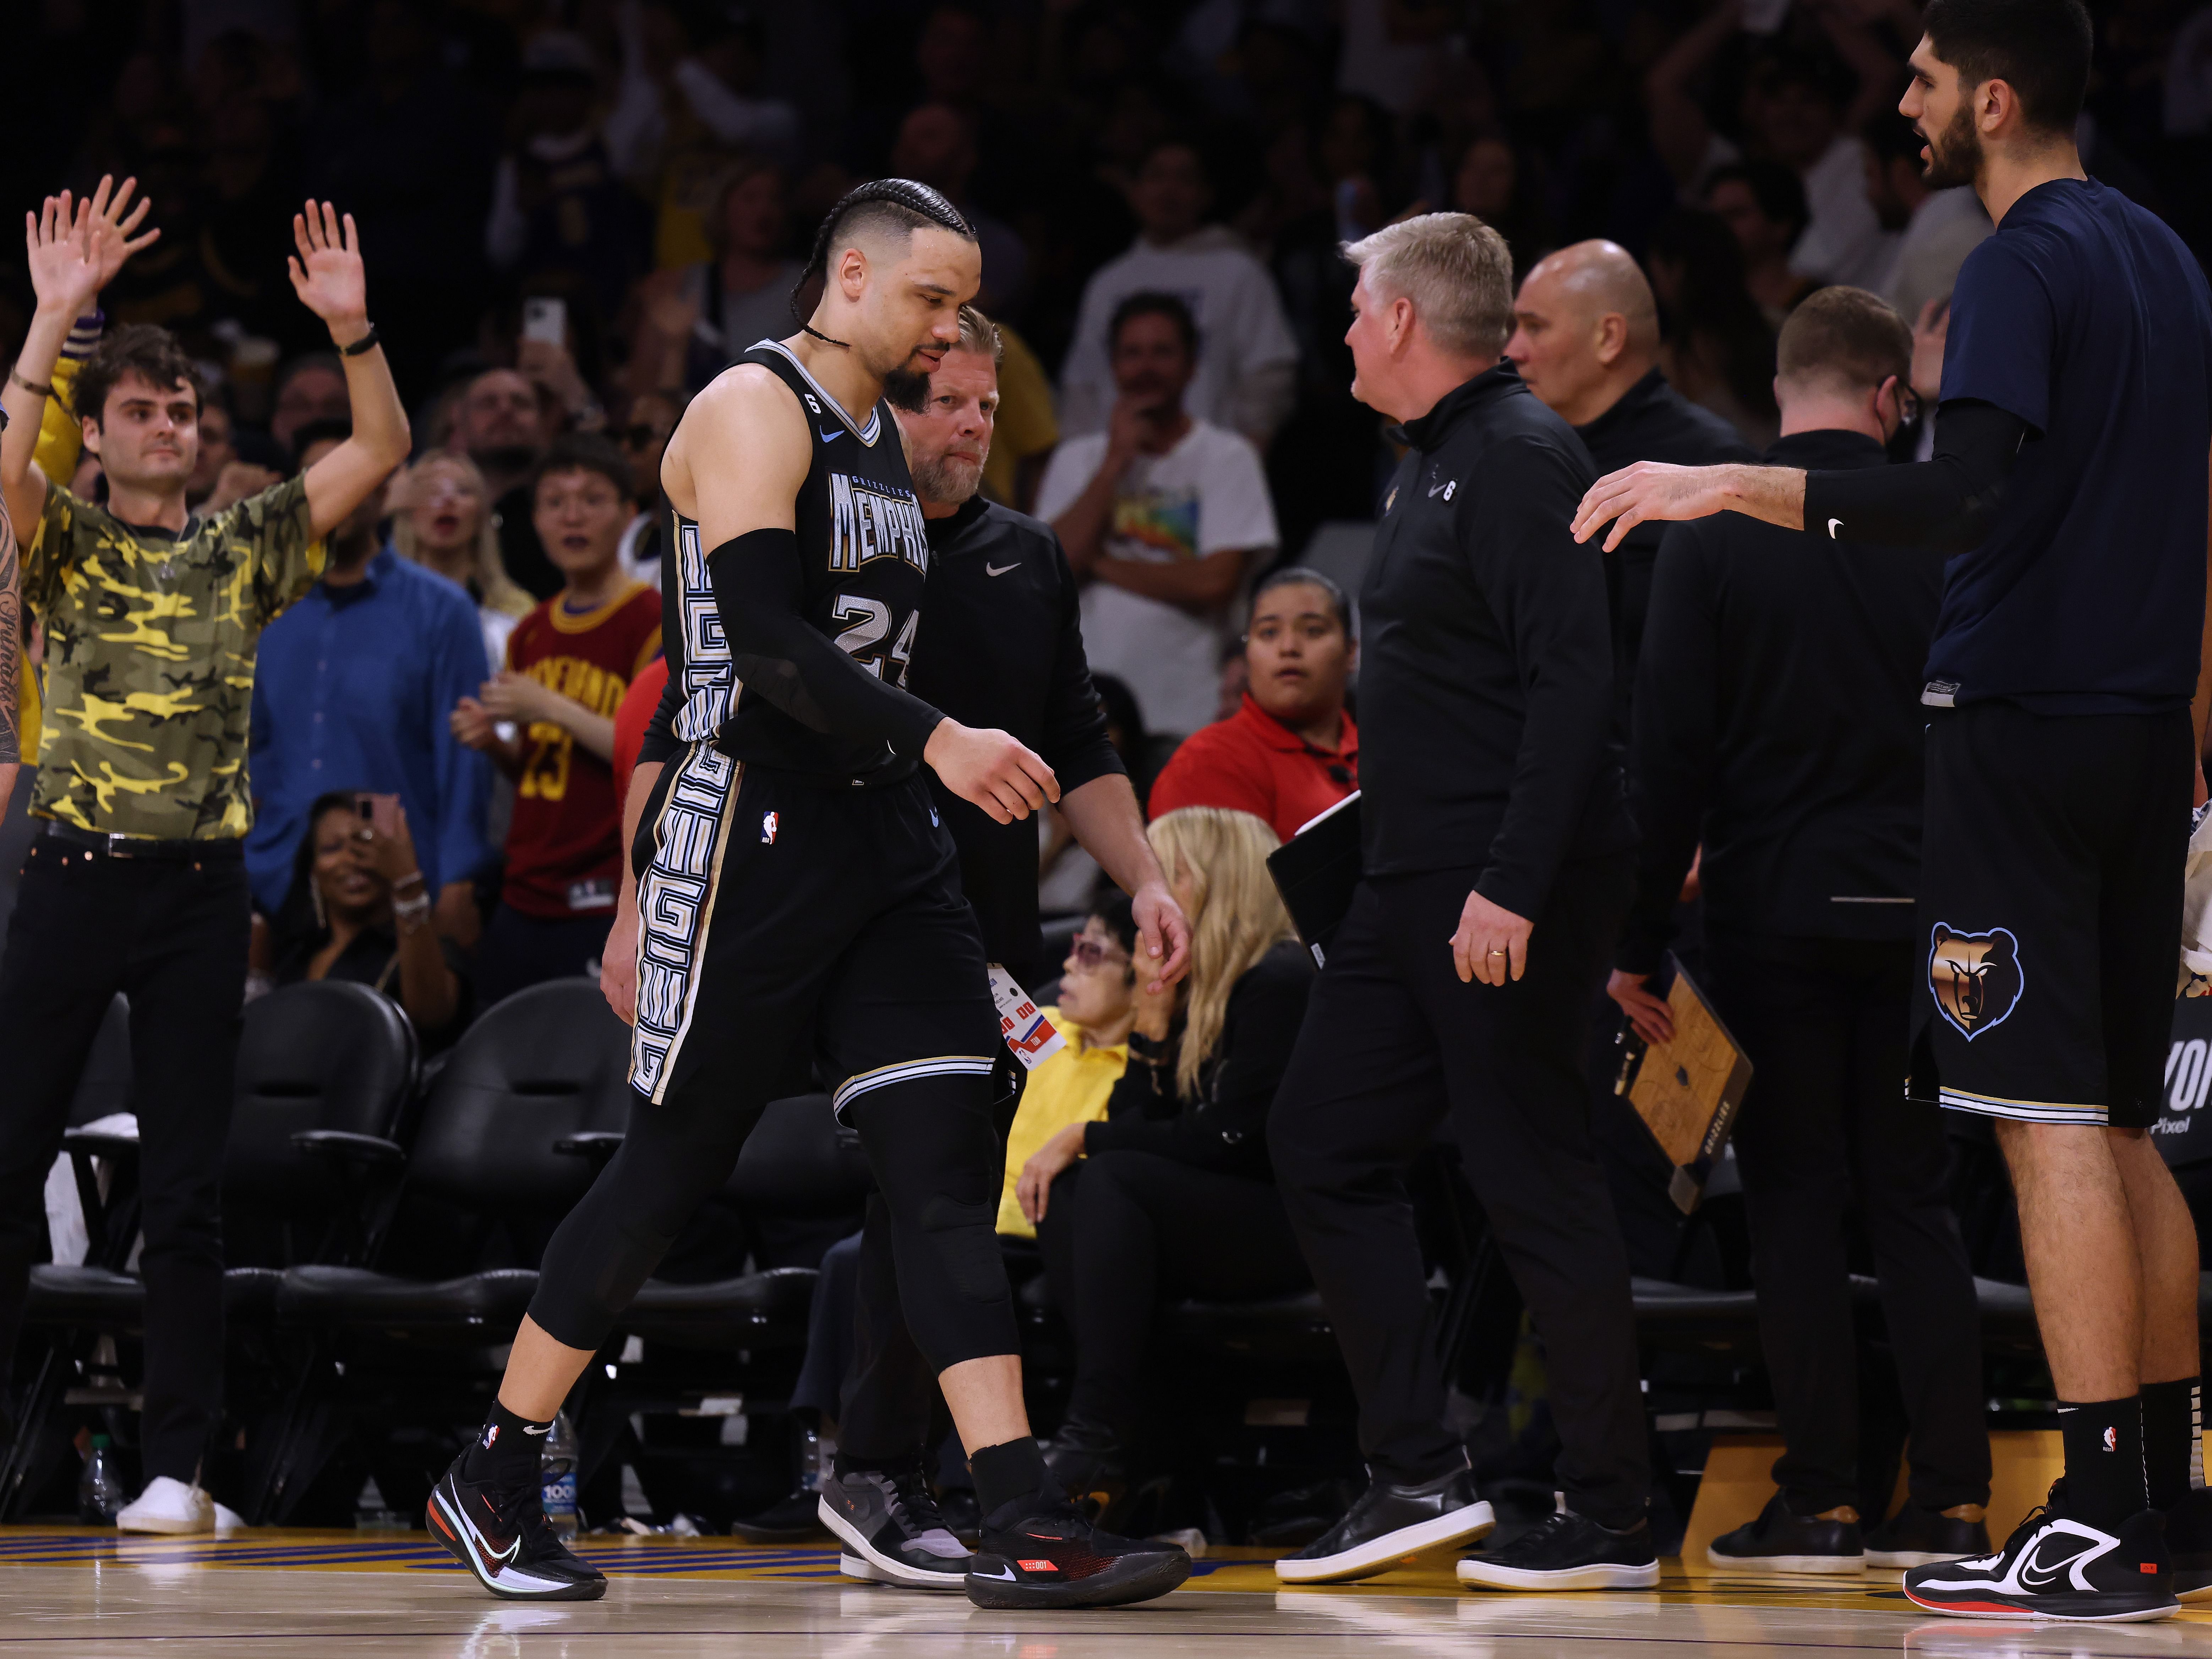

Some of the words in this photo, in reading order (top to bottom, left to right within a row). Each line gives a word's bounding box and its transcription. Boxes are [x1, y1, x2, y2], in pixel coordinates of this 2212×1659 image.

[804, 393, 821, 414] 6
[852, 475, 911, 497] GRIZZLIES
[1443, 480, 1457, 501] 6
[832, 593, 920, 689] 24
[519, 721, 573, 801] 23
[2150, 1116, 2191, 1135] Pixel
[1036, 1561, 1047, 1569] 001
